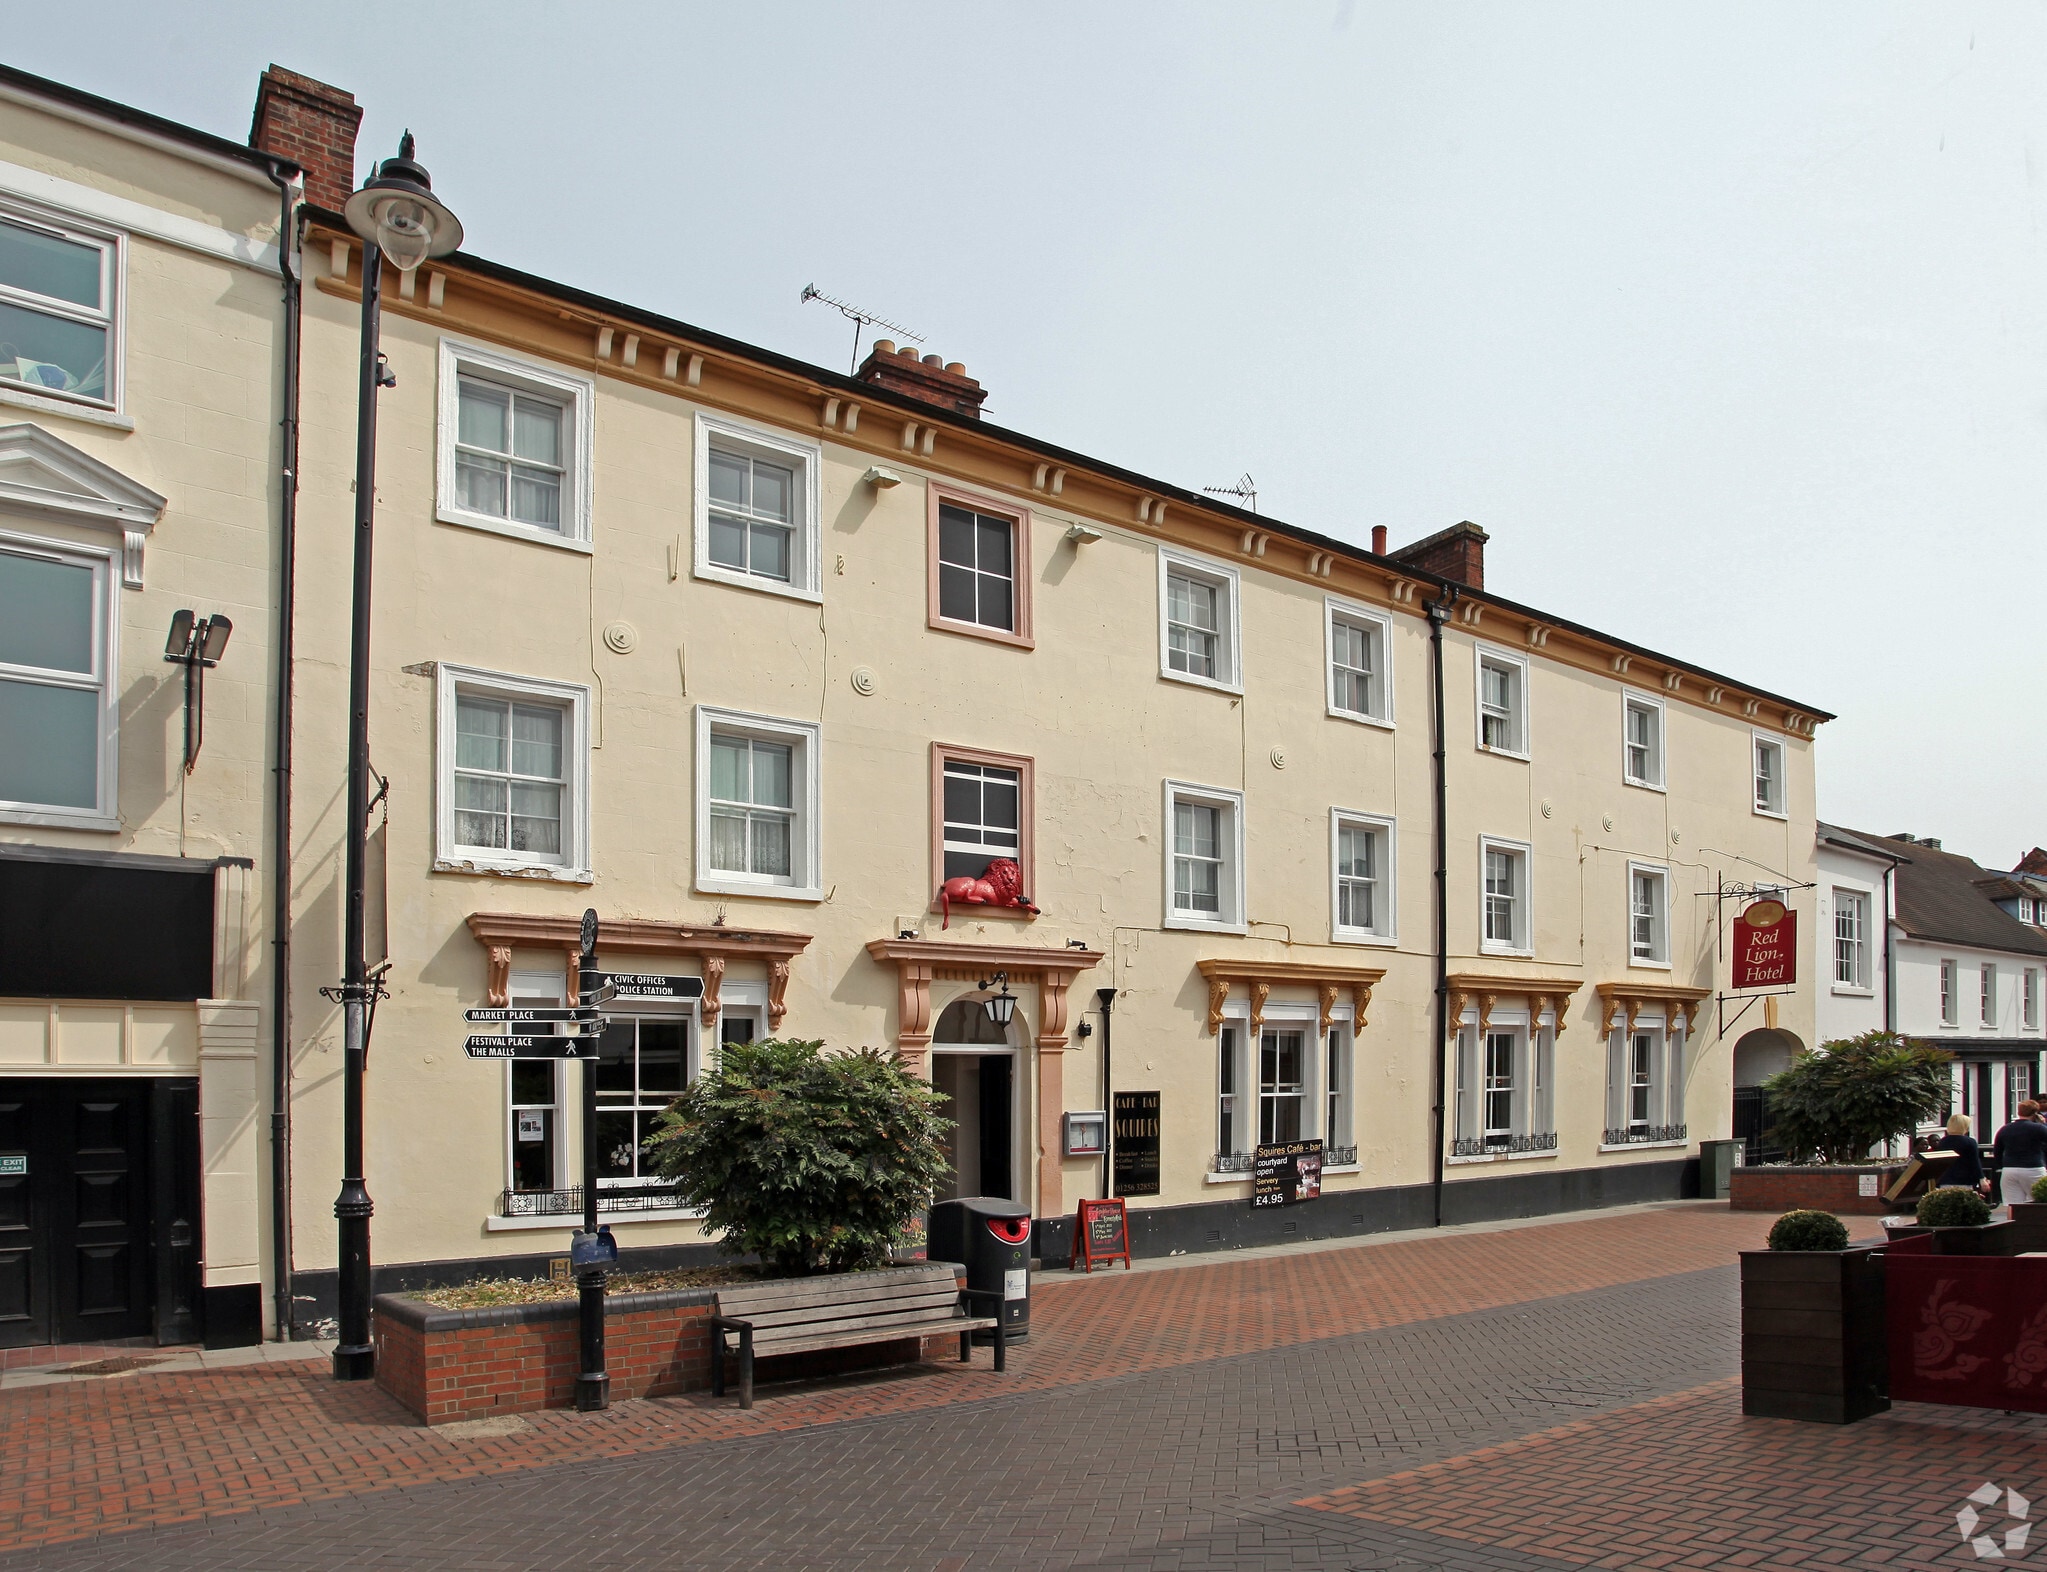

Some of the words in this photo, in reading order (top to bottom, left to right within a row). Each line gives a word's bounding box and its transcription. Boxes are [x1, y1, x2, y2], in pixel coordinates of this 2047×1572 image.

[1751, 929, 1779, 946] Red
[1745, 947, 1784, 964] Lion
[1745, 964, 1784, 982] Hotel
[614, 975, 635, 984] CIVIC
[637, 975, 666, 985] OFFICES
[642, 986, 673, 995] STATION
[471, 1010, 506, 1020] MARKET
[509, 1010, 534, 1020] PLACE
[471, 1037, 506, 1046] FESTIVAL
[508, 1037, 533, 1046] PLACE
[471, 1047, 487, 1056] THE
[488, 1047, 515, 1056] MALLS
[1116, 1118, 1158, 1138] SQUIRES
[1257, 1147, 1286, 1157] Squires
[1286, 1143, 1304, 1154] Café
[1309, 1143, 1322, 1151] bar
[1257, 1156, 1288, 1167] courtyard
[1256, 1168, 1274, 1177] open
[1256, 1178, 1279, 1186] Servery
[1115, 1184, 1135, 1192] 01256
[1256, 1185, 1272, 1194] lunch
[1256, 1193, 1283, 1206] £4.95
